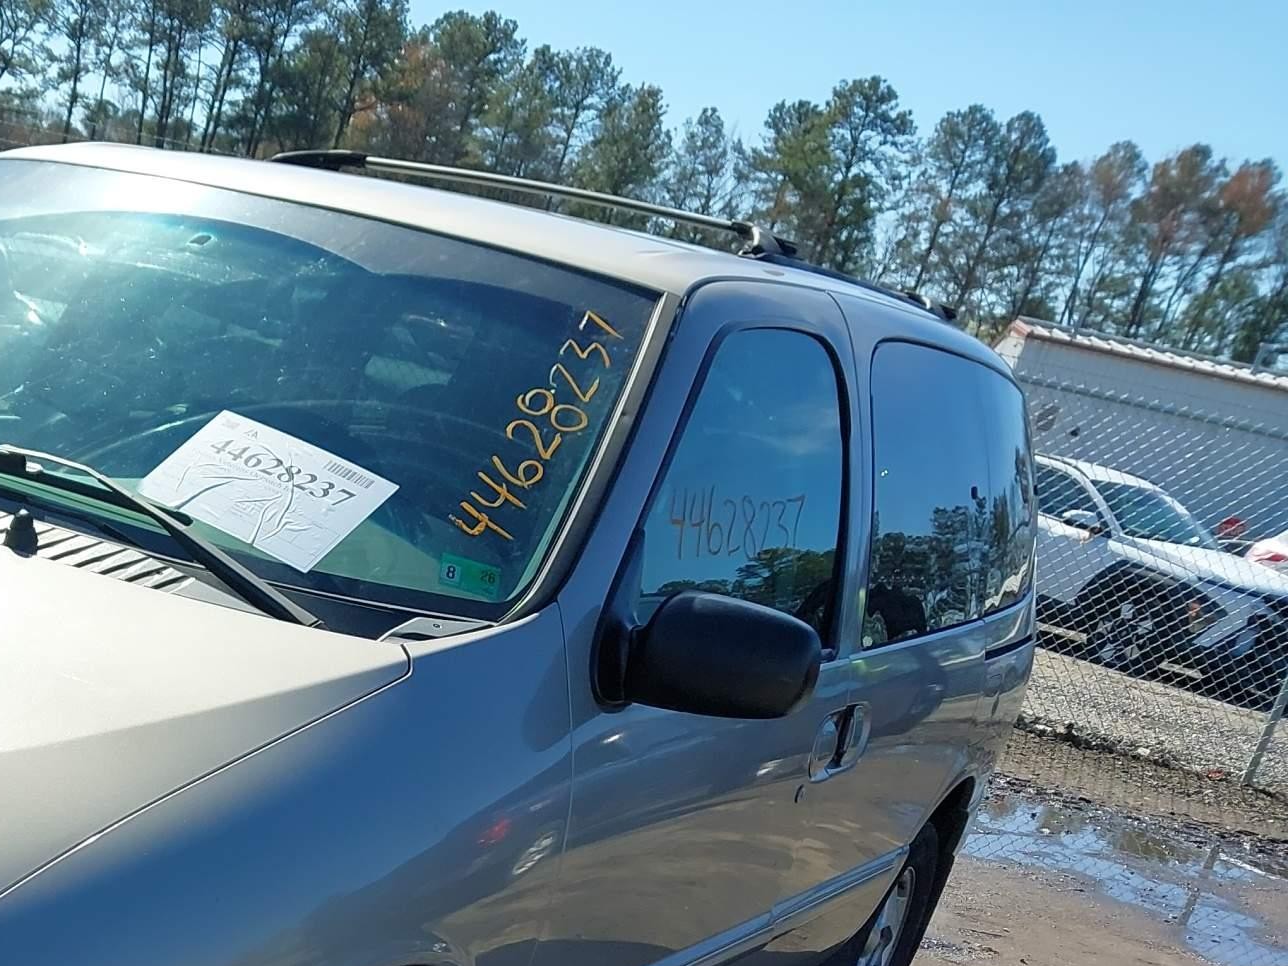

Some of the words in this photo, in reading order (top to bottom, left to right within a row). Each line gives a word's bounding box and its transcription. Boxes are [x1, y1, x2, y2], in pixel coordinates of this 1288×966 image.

[448, 309, 624, 541] 44628237
[210, 439, 357, 506] 44628237
[671, 484, 806, 563] 44628237
[446, 564, 456, 580] 8
[480, 570, 496, 585] 26
